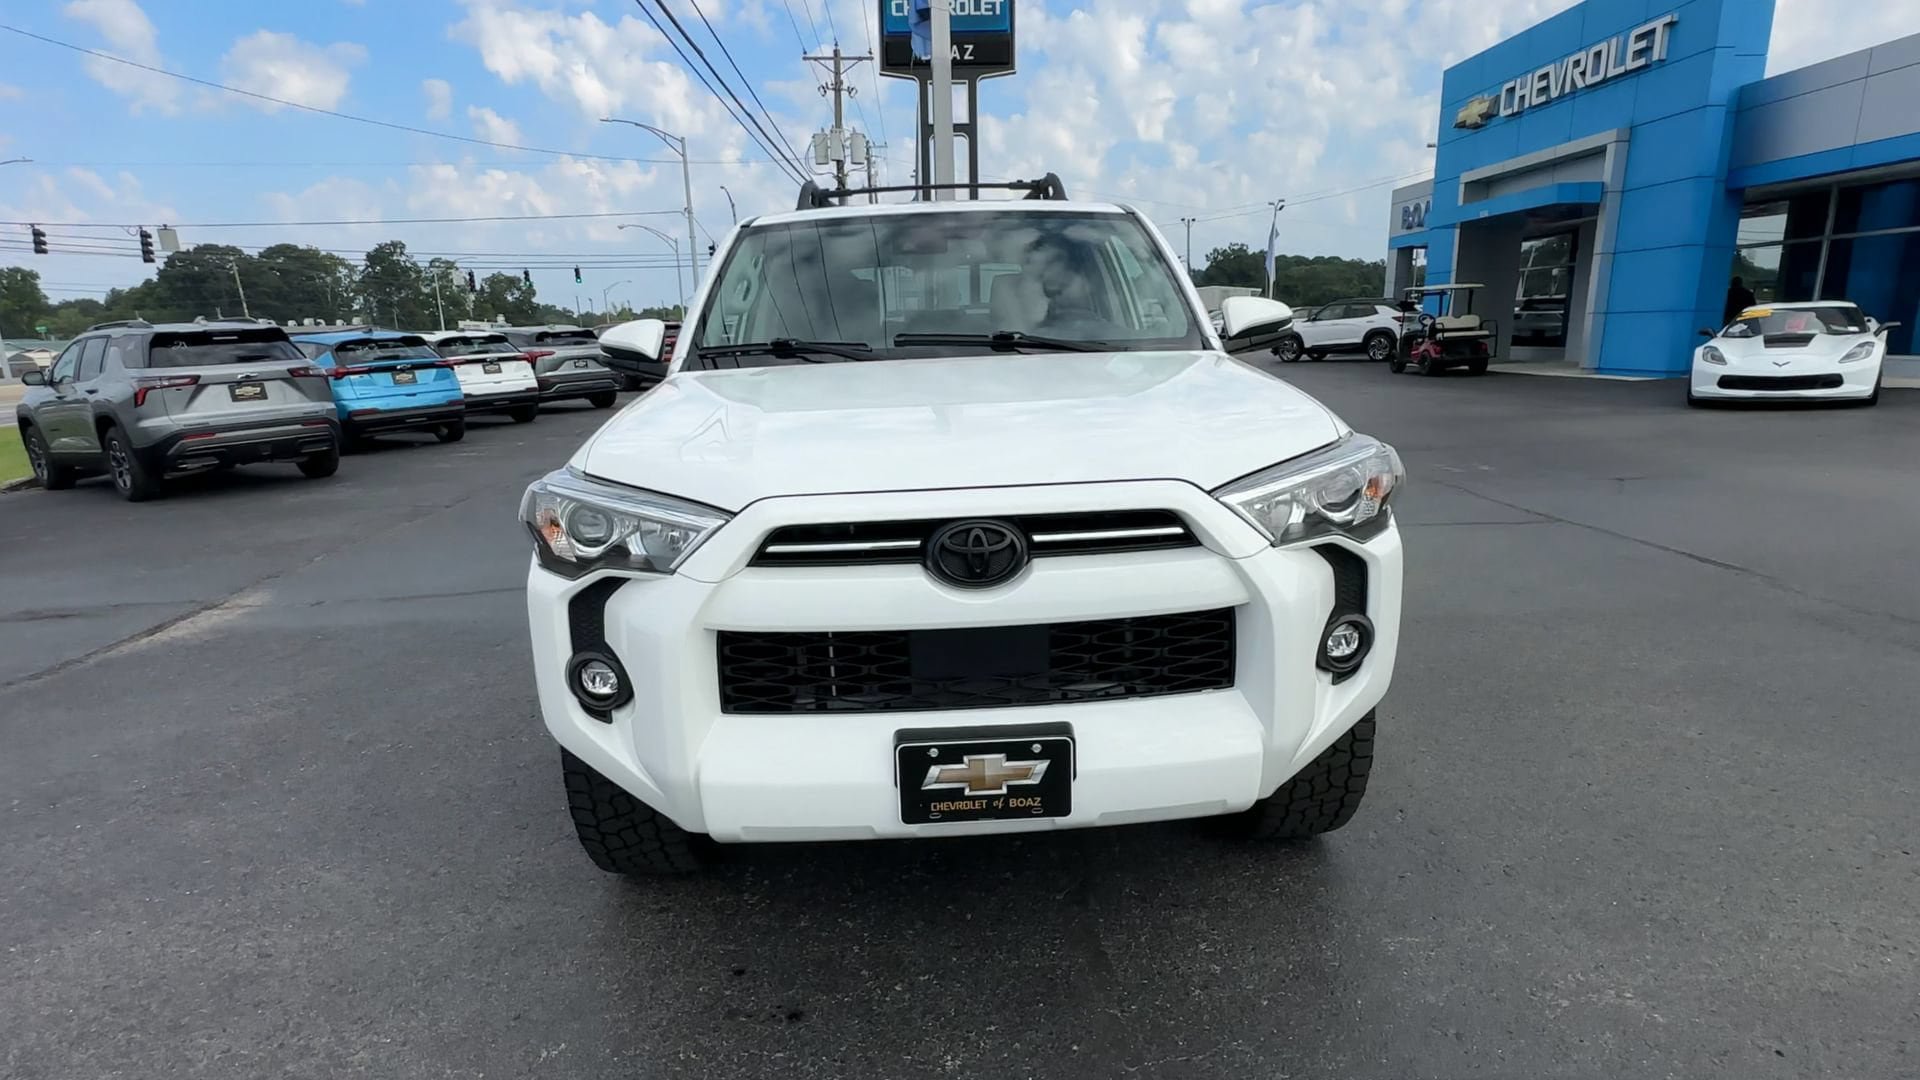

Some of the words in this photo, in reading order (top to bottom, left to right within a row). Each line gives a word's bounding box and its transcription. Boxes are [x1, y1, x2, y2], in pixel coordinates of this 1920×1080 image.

[891, 0, 1004, 16] CHROLET
[1500, 13, 1678, 117] CHEVROLET
[931, 799, 987, 812] CHEVROLET
[993, 797, 1005, 809] of
[1009, 797, 1042, 808] BOAZ
